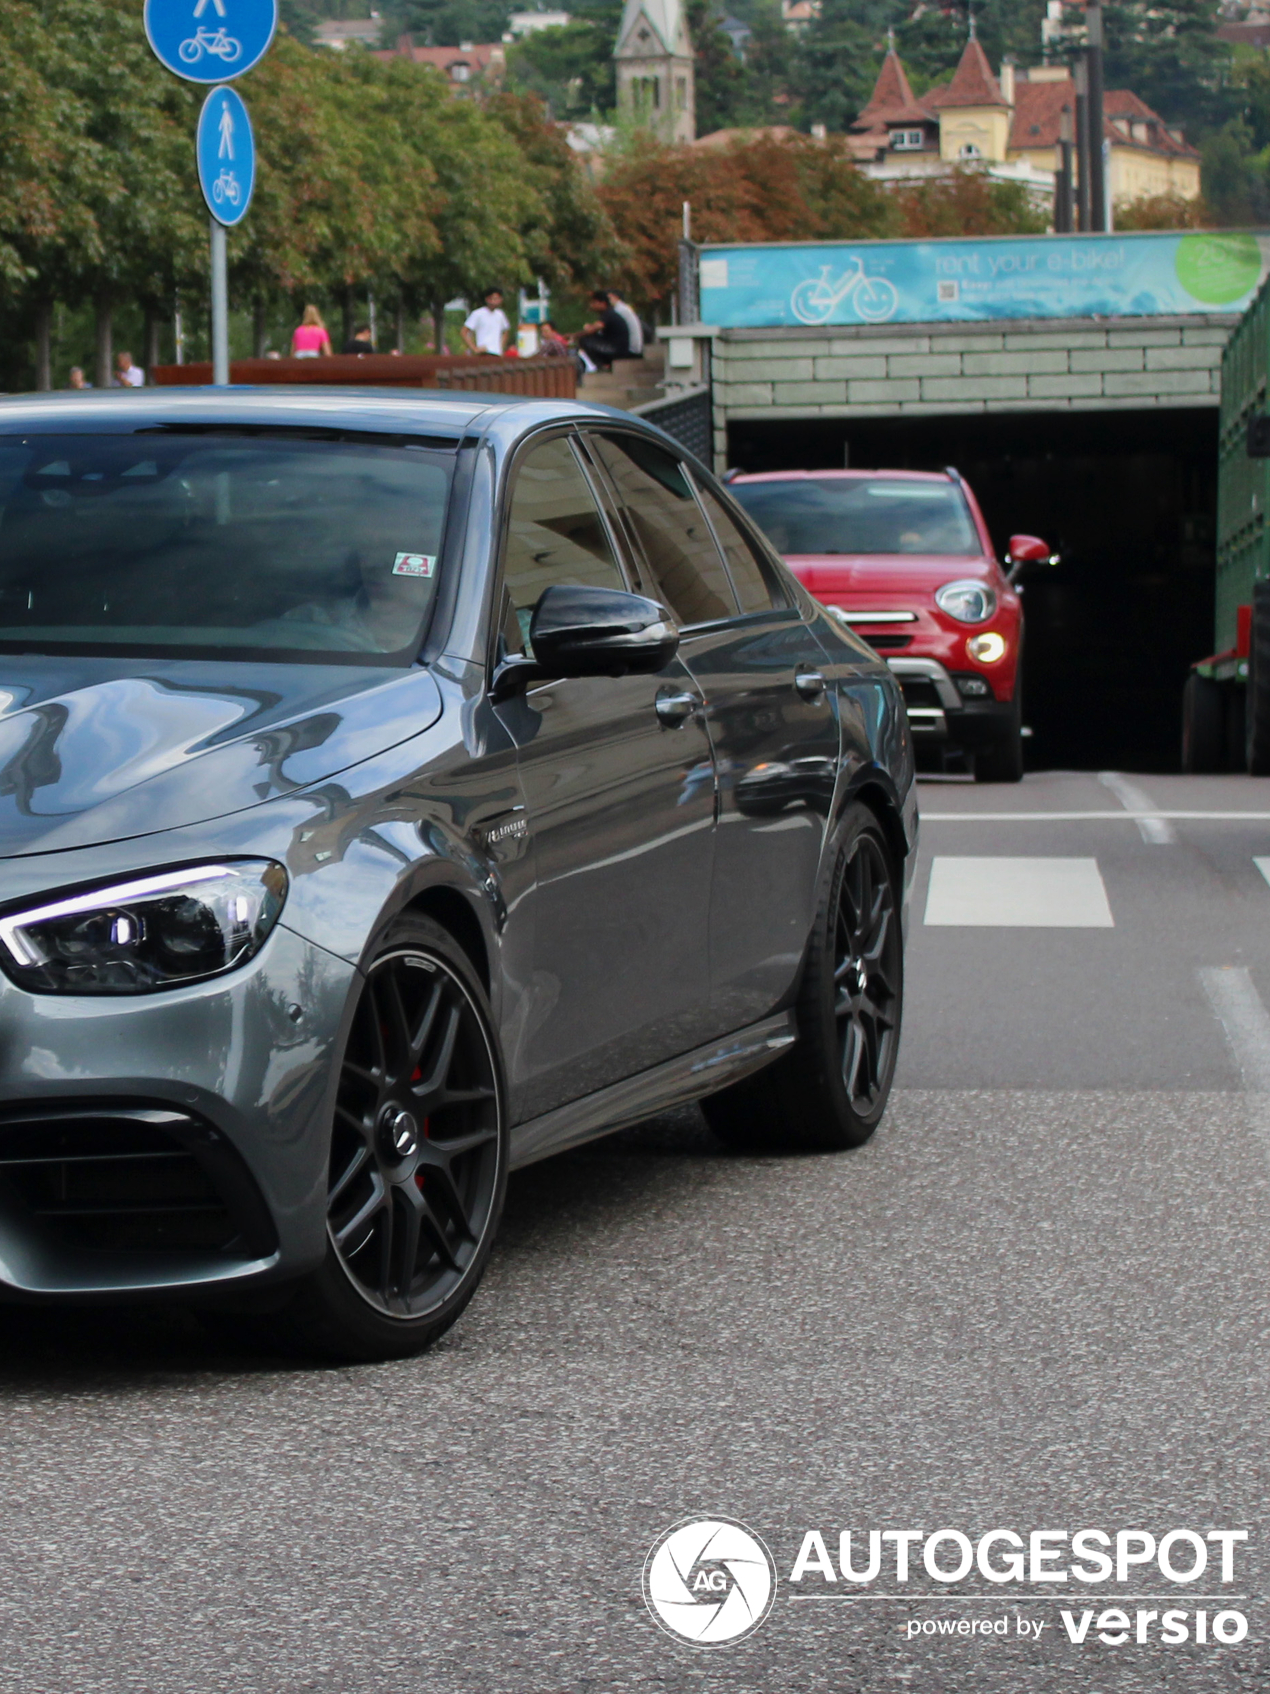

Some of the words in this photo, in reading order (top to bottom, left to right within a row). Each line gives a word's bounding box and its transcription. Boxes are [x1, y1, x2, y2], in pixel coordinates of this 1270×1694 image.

[936, 253, 981, 274] rent
[988, 253, 1039, 276] your
[1047, 248, 1125, 271] e-bike!
